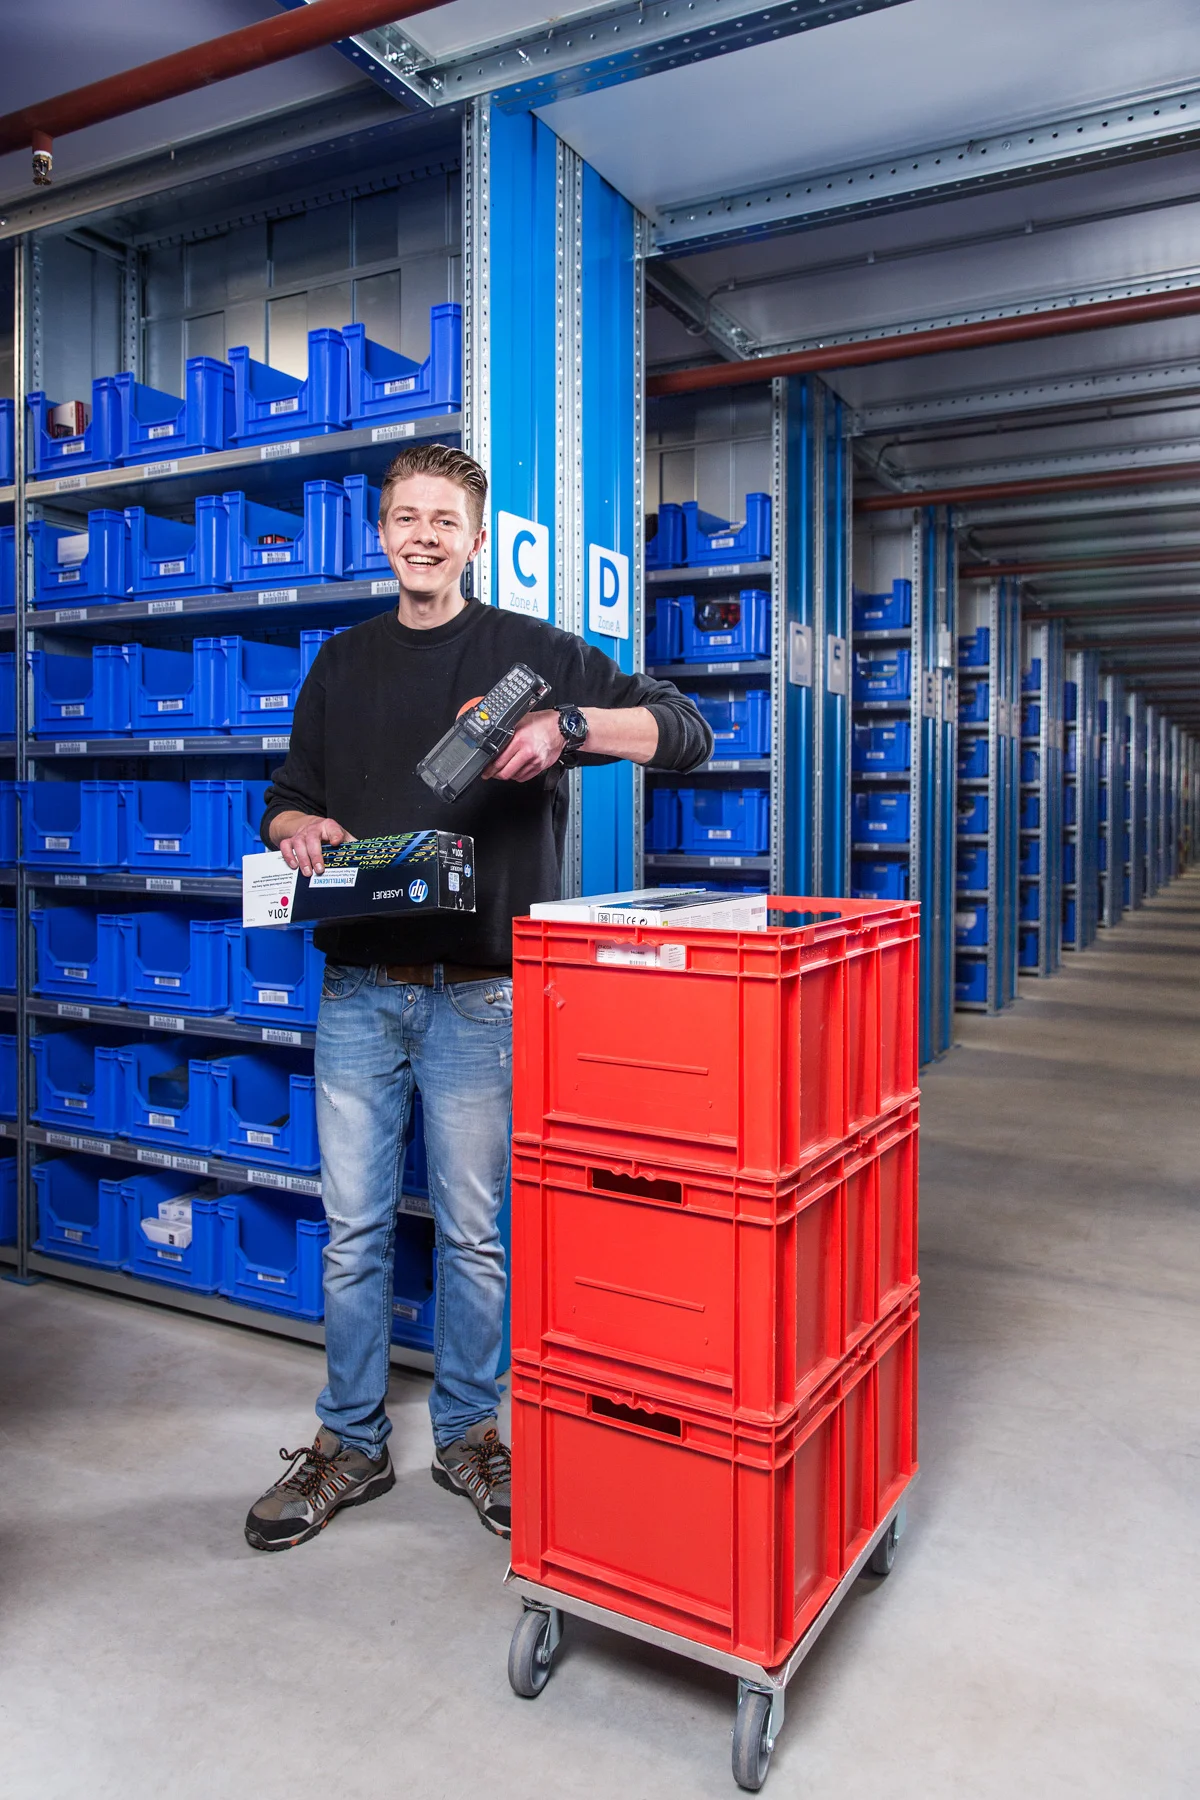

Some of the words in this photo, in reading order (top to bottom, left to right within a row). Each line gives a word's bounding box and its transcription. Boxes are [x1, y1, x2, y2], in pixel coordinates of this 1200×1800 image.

[513, 530, 537, 588] C
[599, 556, 620, 608] D
[510, 593, 530, 610] Zone
[532, 600, 539, 612] A
[598, 616, 614, 631] Zone
[615, 620, 621, 632] A
[338, 840, 408, 851] SYDNEY
[333, 853, 397, 862] MADRID
[372, 888, 404, 900] LASERJET
[267, 908, 289, 919] 201A
